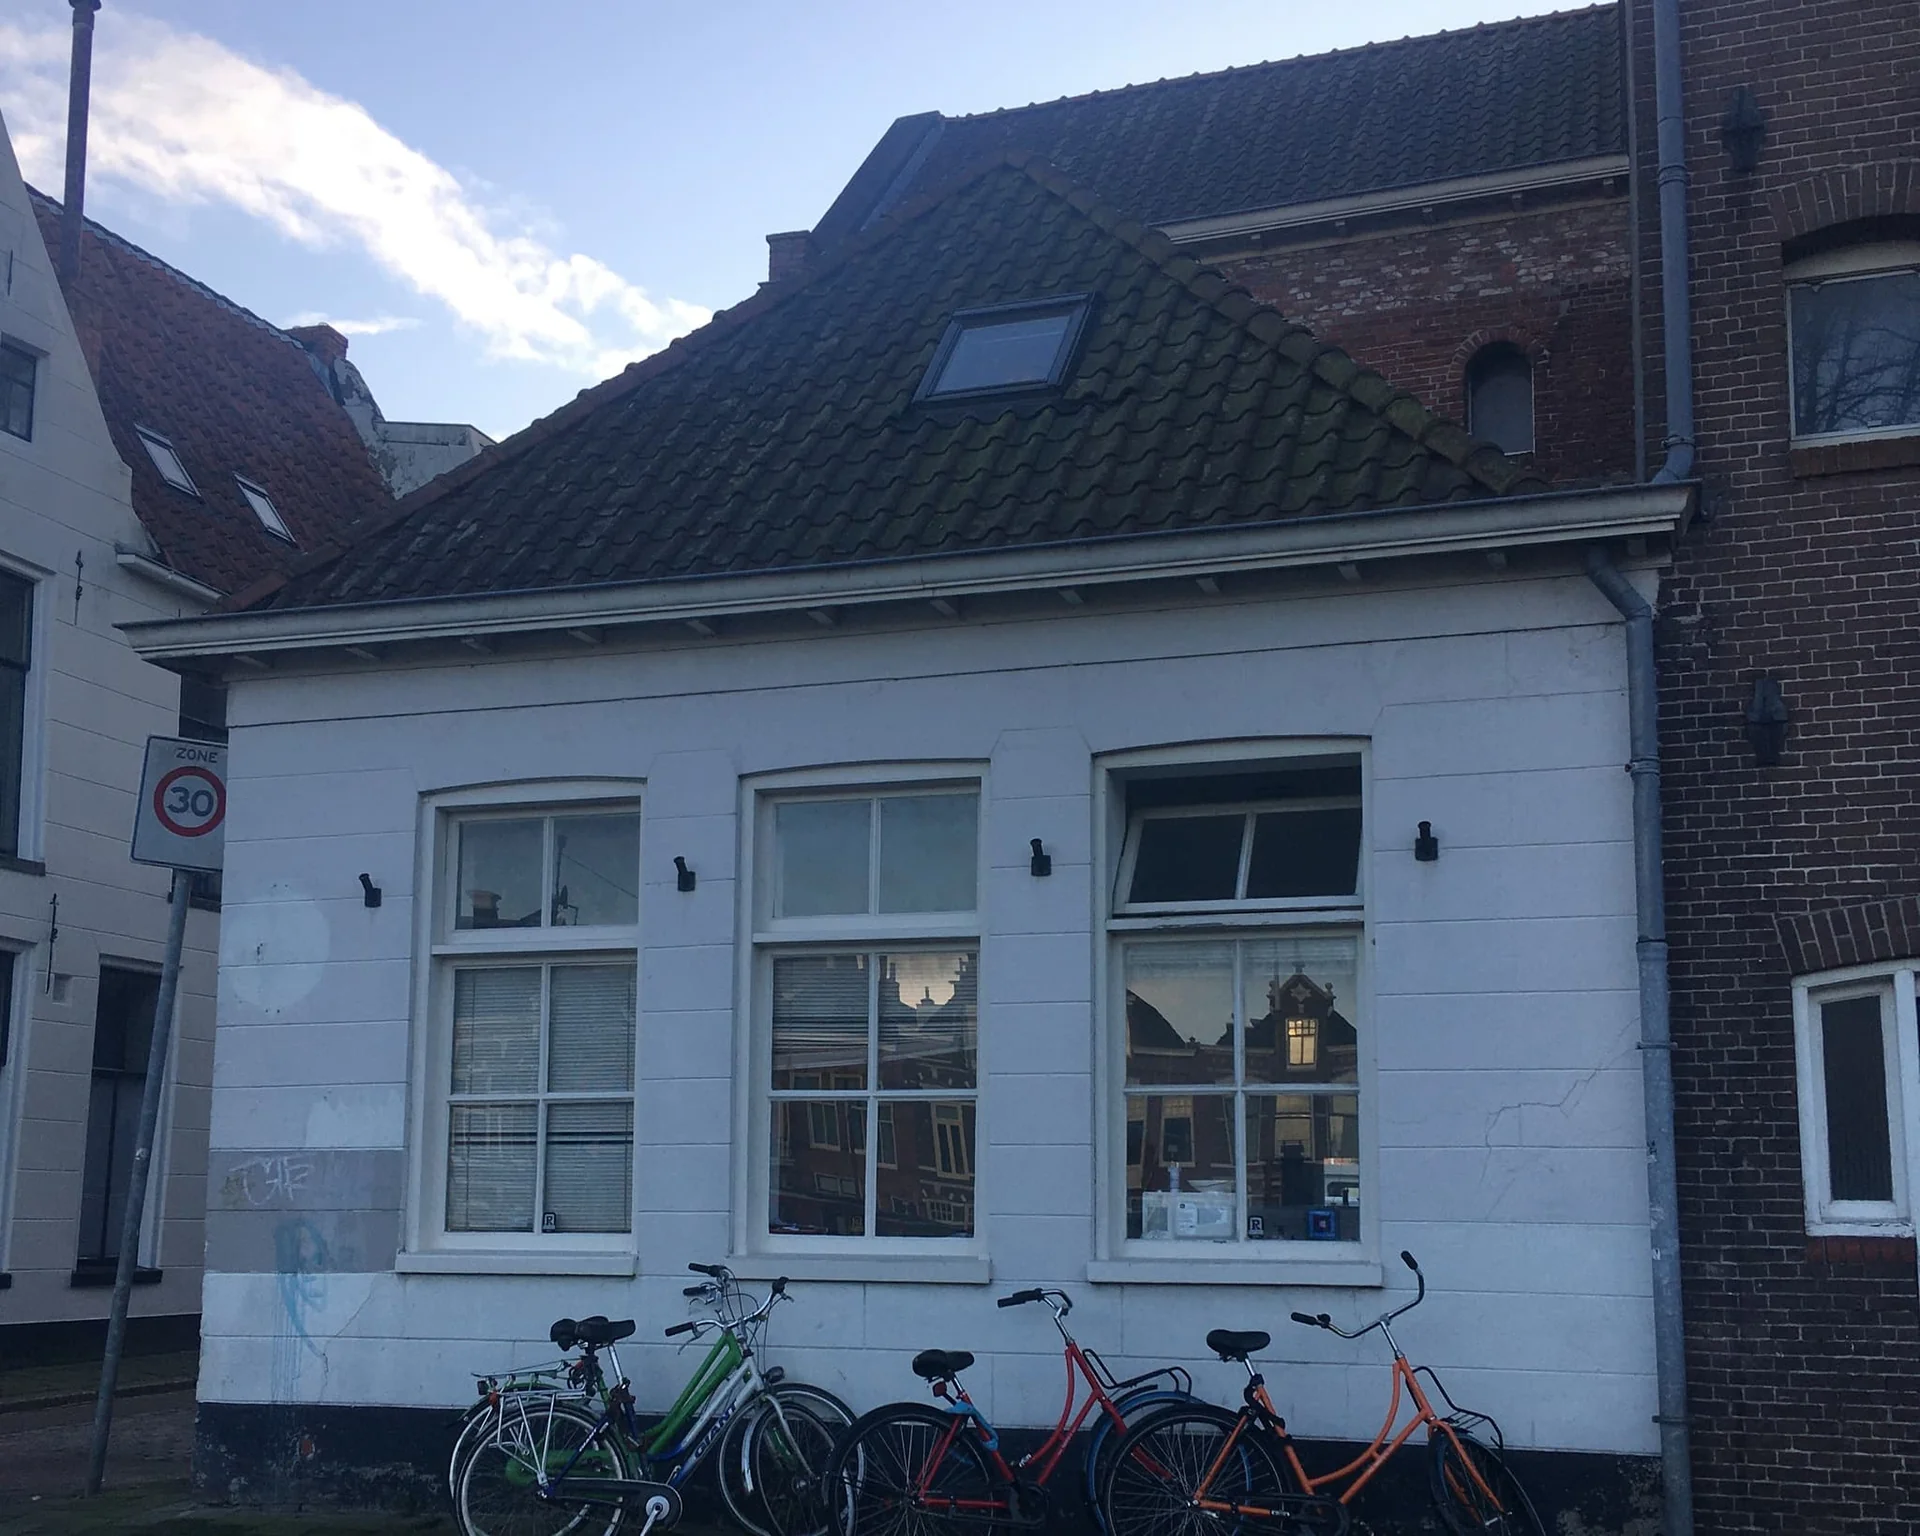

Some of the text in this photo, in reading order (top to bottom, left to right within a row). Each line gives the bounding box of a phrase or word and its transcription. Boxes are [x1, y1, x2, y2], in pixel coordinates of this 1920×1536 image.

[175, 747, 218, 763] ZONE
[167, 786, 214, 817] 30
[694, 1399, 738, 1459] GIANT
